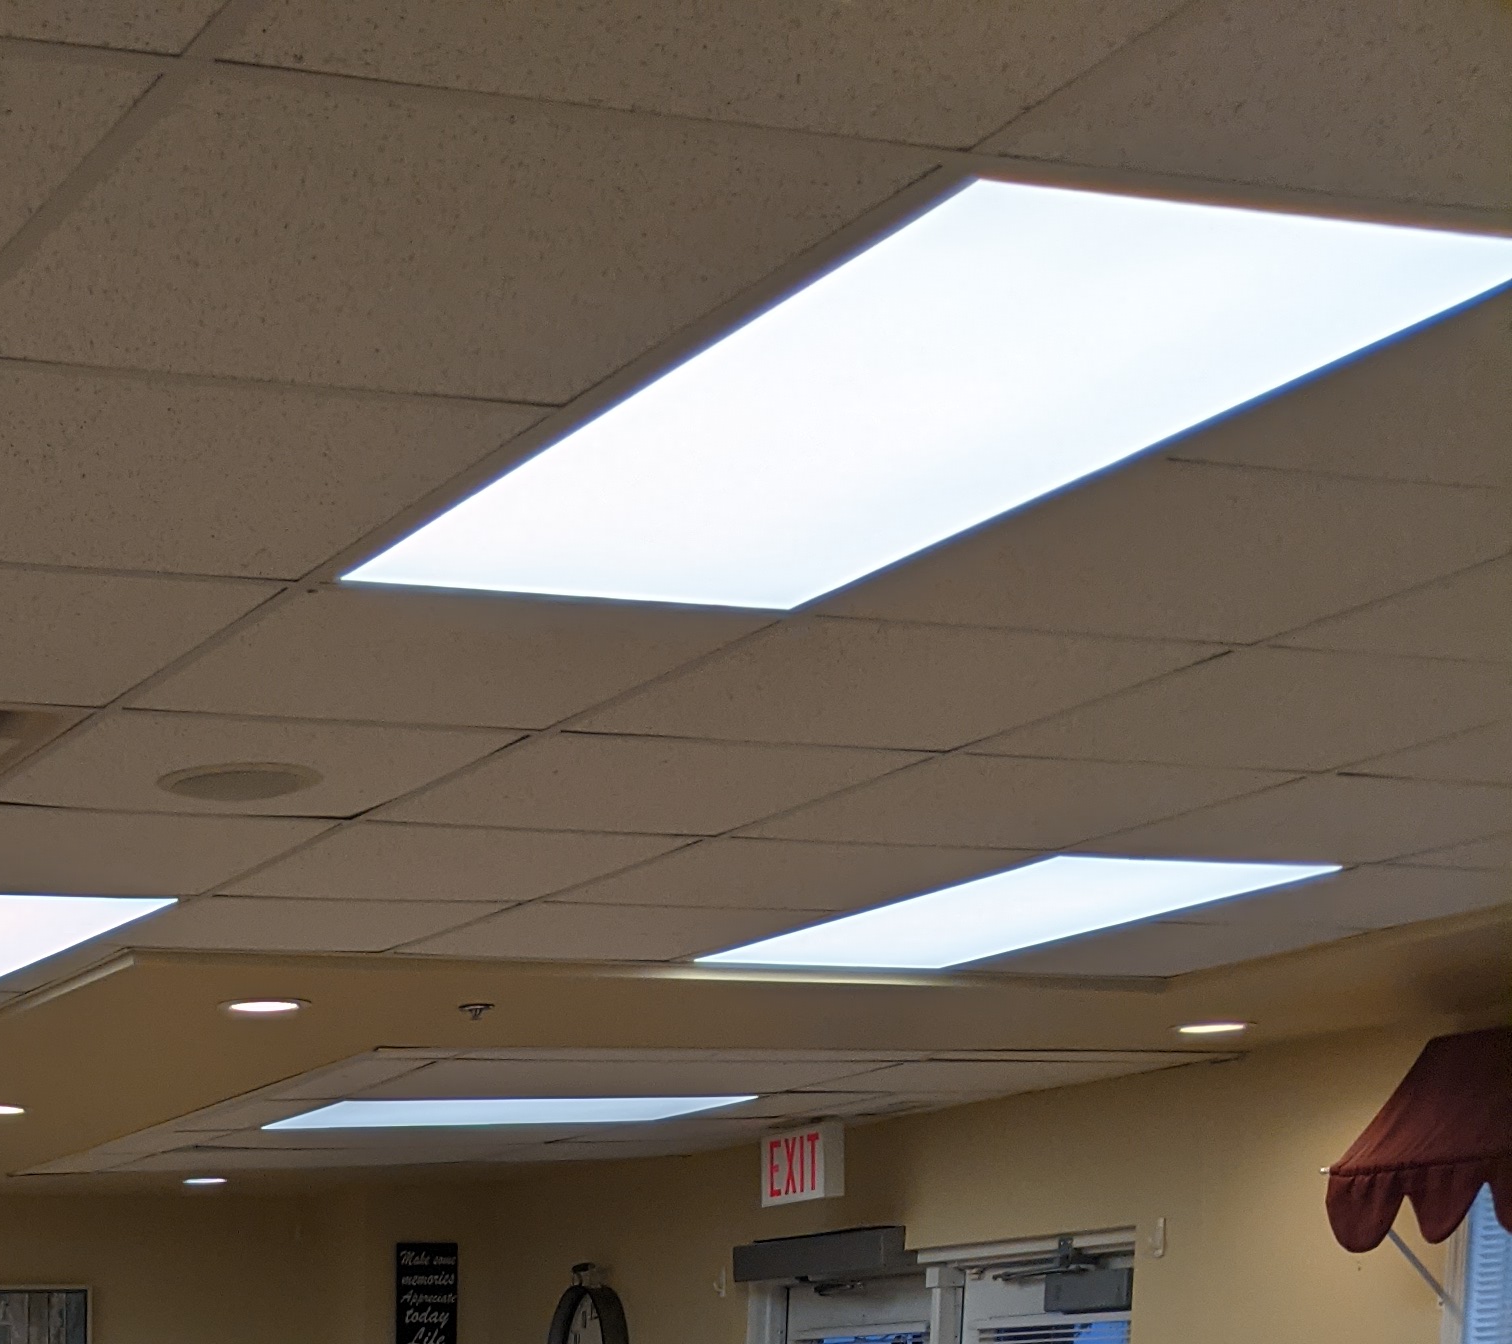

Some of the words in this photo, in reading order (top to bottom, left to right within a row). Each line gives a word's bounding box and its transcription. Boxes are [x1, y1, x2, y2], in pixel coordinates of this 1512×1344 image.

[769, 1132, 819, 1197] EXIT
[400, 1250, 430, 1265] Make
[402, 1271, 455, 1286] memories
[400, 1290, 457, 1306] Appreciate
[405, 1306, 449, 1329] today
